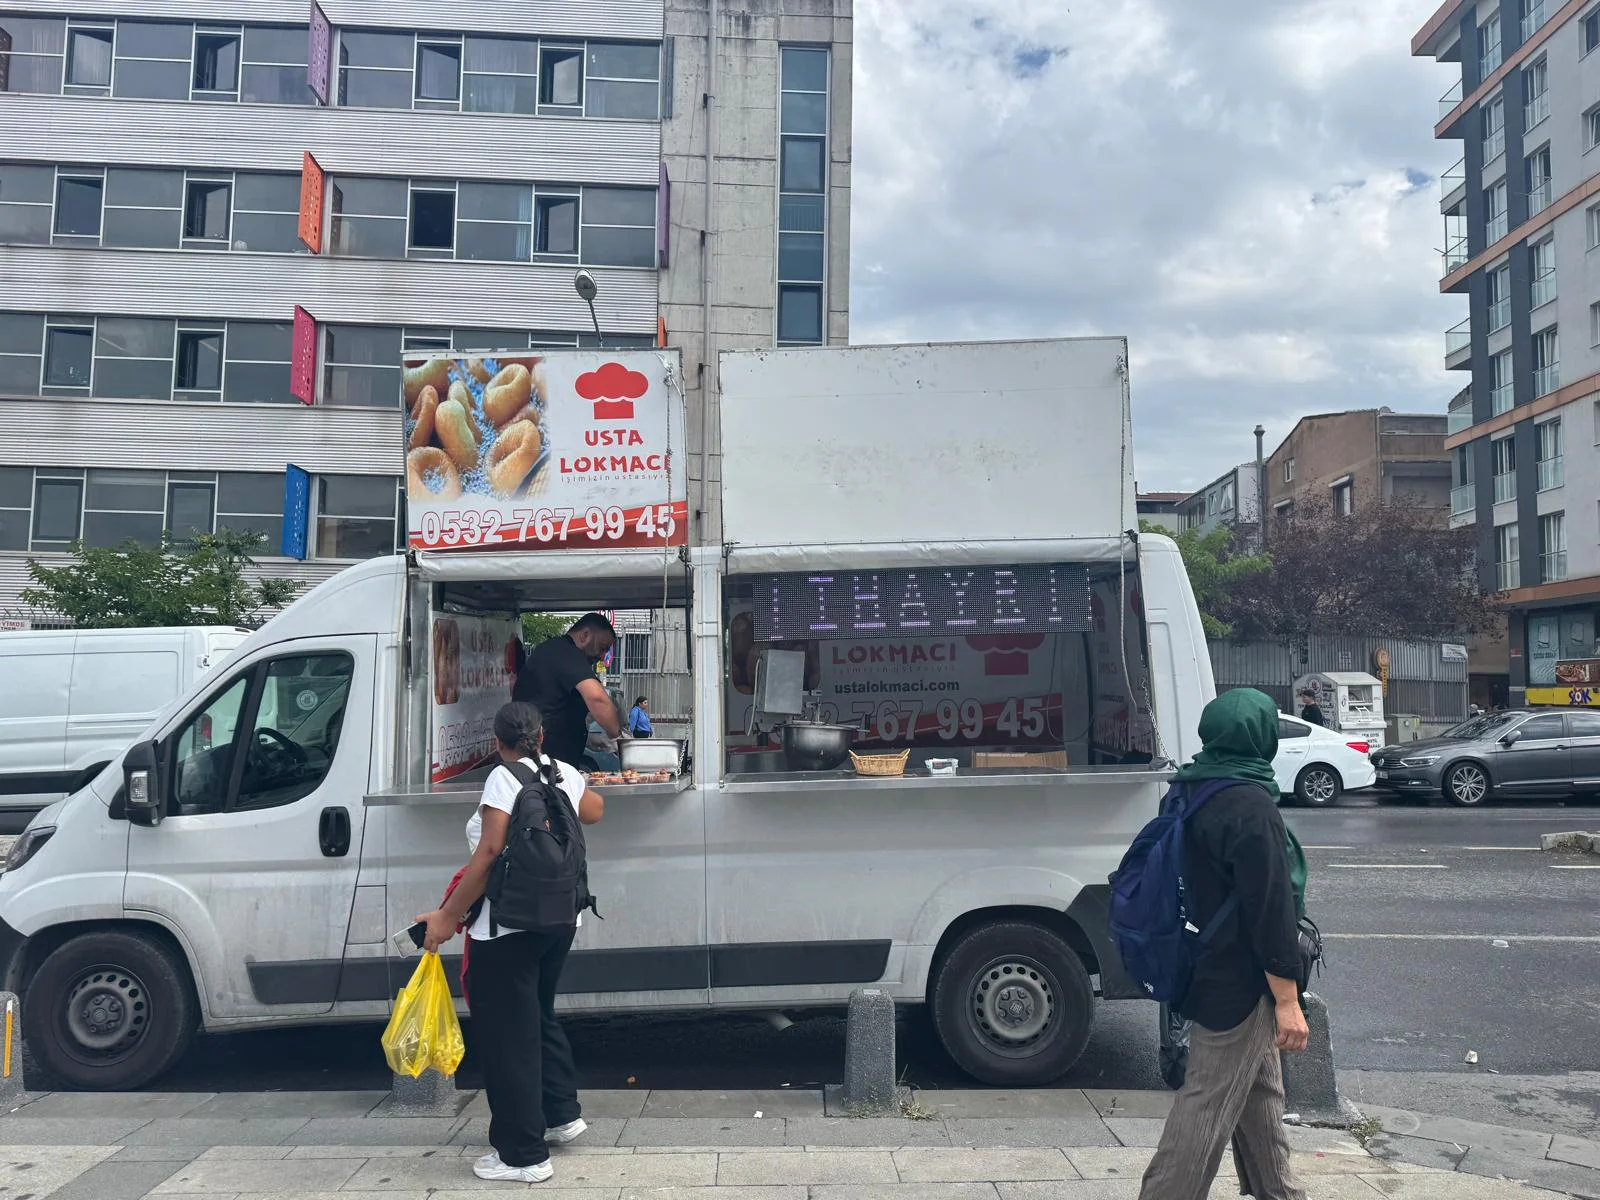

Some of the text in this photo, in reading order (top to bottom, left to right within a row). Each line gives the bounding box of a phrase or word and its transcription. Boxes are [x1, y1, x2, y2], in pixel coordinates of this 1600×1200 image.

[584, 429, 644, 446] USTA
[614, 473, 670, 481] ustasıyı
[421, 504, 676, 545] 0532 767 99 45
[832, 642, 956, 665] LOKMACI
[834, 679, 960, 694] ustalokmaci.com
[851, 699, 924, 742] 767
[935, 698, 983, 741] 99
[996, 696, 1045, 738] 45
